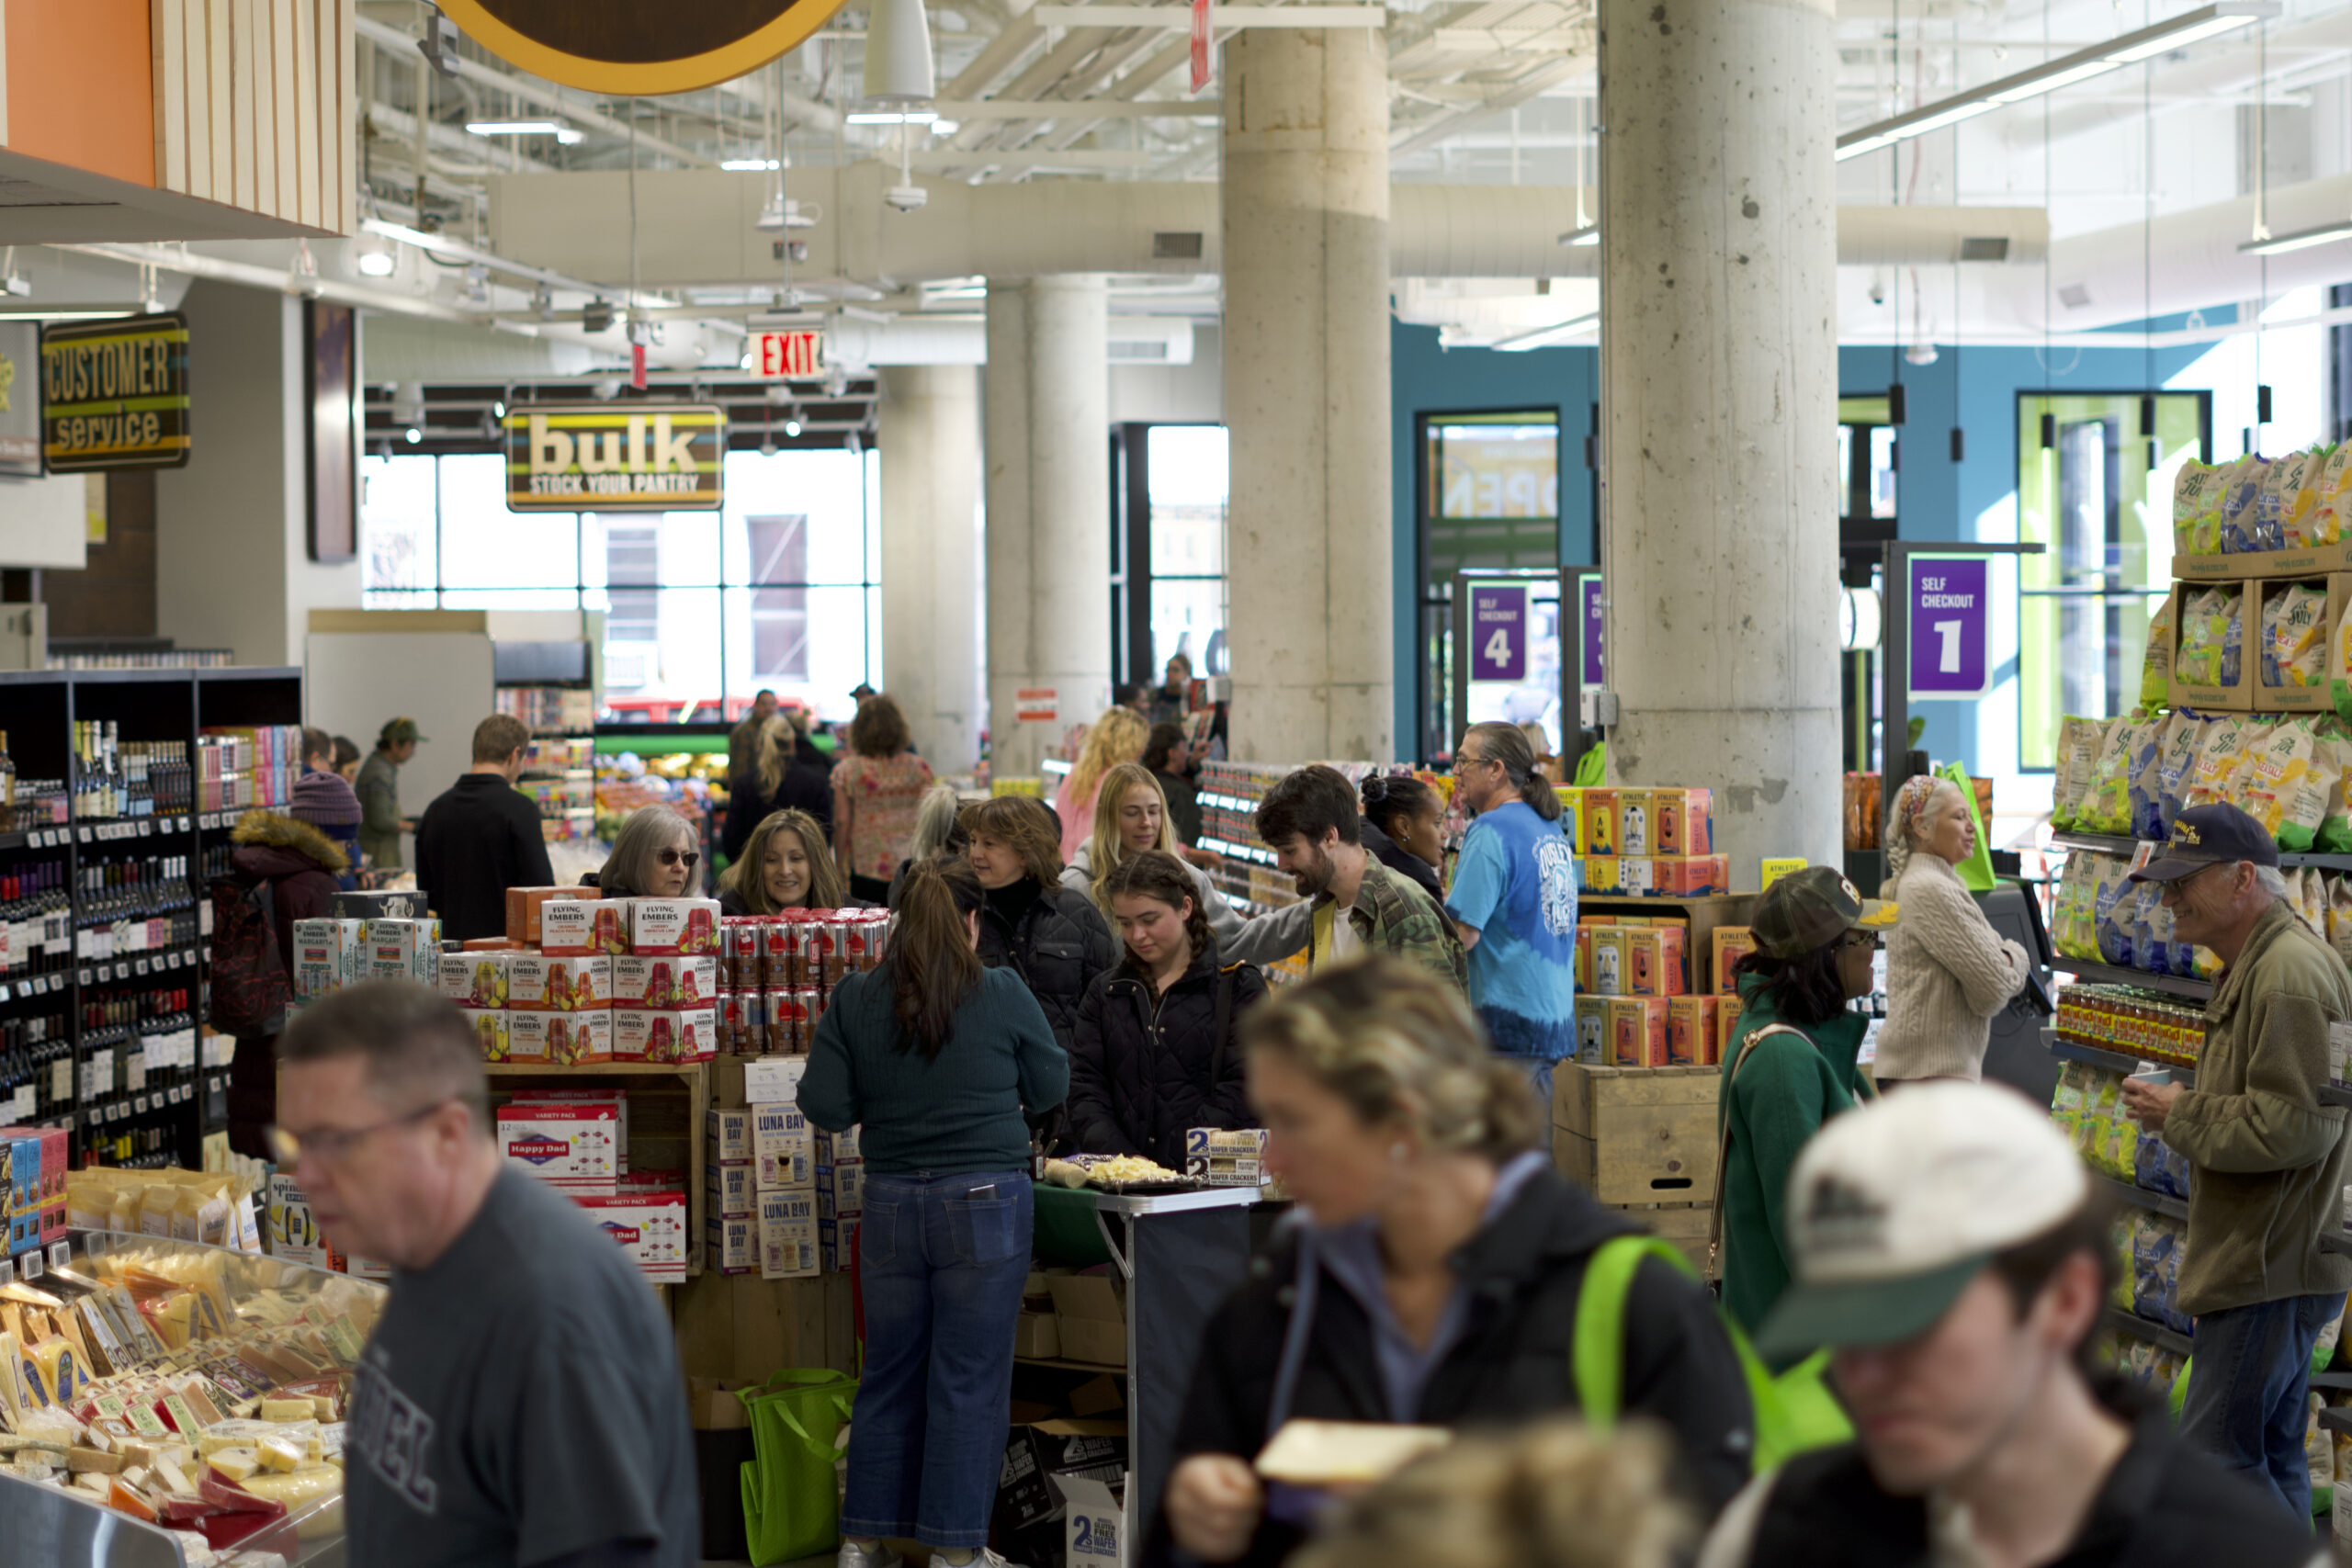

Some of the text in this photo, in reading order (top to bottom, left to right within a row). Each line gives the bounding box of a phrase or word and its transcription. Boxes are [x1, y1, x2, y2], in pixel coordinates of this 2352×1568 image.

[762, 334, 815, 376] EXIT
[49, 337, 168, 401] CUSTOMER
[57, 402, 160, 450] service
[529, 414, 698, 475] bulk
[529, 473, 699, 496] STOCK YOUR PANTRY
[1921, 577, 1946, 592] SELF
[1478, 598, 1498, 609] SELF
[1921, 594, 1974, 608] CHECKOUT
[1478, 611, 1518, 621] CHECKOUT
[1484, 628, 1512, 668] 4
[1933, 619, 1962, 673] 1
[1589, 793, 1611, 801] ATHLETIC
[548, 913, 585, 921] EMBERS
[513, 1021, 541, 1030] EMBERS
[617, 1021, 645, 1029] EMBERS
[724, 1117, 743, 1129] LUNA
[758, 1114, 805, 1131] LUNA BAY
[727, 1128, 741, 1140] BAY
[511, 1145, 544, 1153] Happy
[727, 1170, 745, 1182] LUNA
[841, 1168, 855, 1180] LUNA
[729, 1181, 742, 1193] BAY
[842, 1179, 854, 1191] BAY
[763, 1201, 810, 1219] LUNA BAY
[728, 1224, 747, 1236] LUNA
[729, 1235, 745, 1247] BAY
[1084, 1438, 1113, 1450] WAFER
[1094, 1522, 1115, 1530] GLUTEN
[1094, 1529, 1115, 1538] FREE
[1093, 1536, 1116, 1550] WAFER
